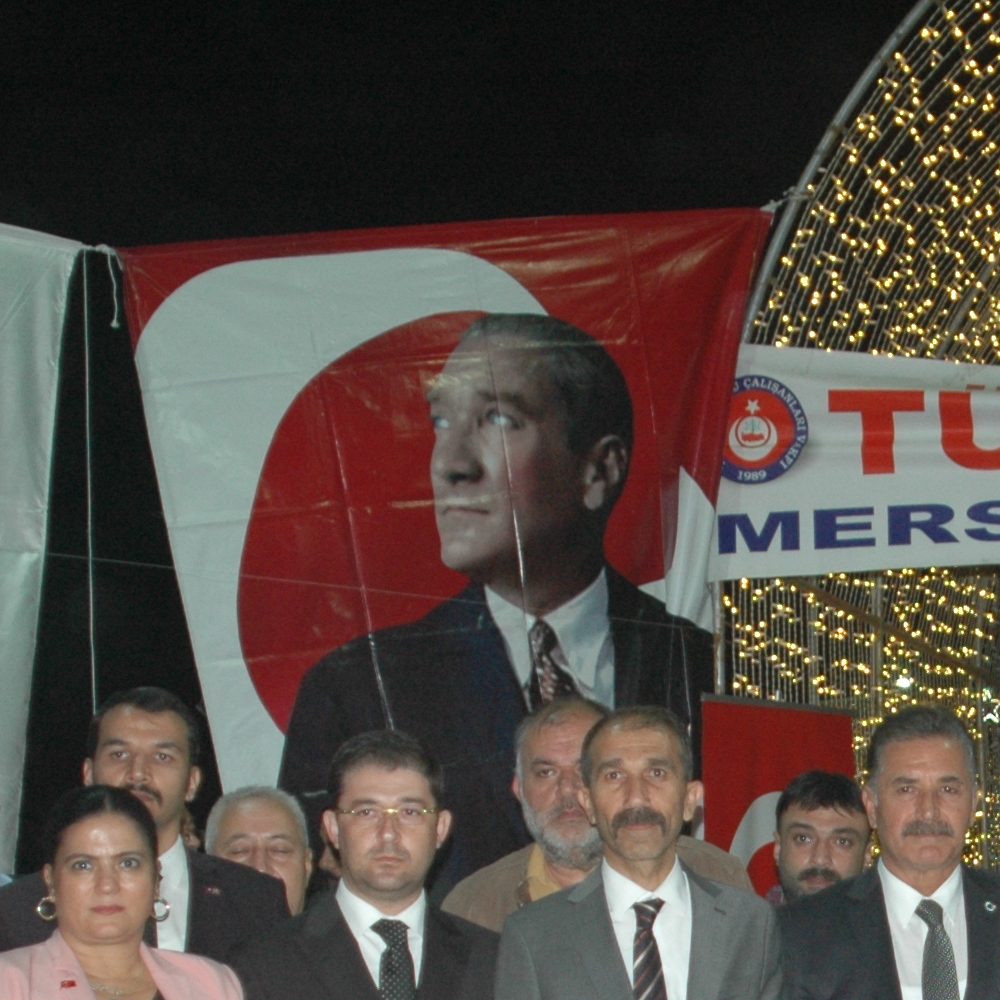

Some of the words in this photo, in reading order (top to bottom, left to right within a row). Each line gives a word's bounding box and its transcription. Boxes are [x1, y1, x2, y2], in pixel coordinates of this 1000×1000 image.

[743, 378, 807, 431] ÇALIŞANLARI
[779, 434, 807, 470] VAKFI
[737, 470, 767, 481] 1989
